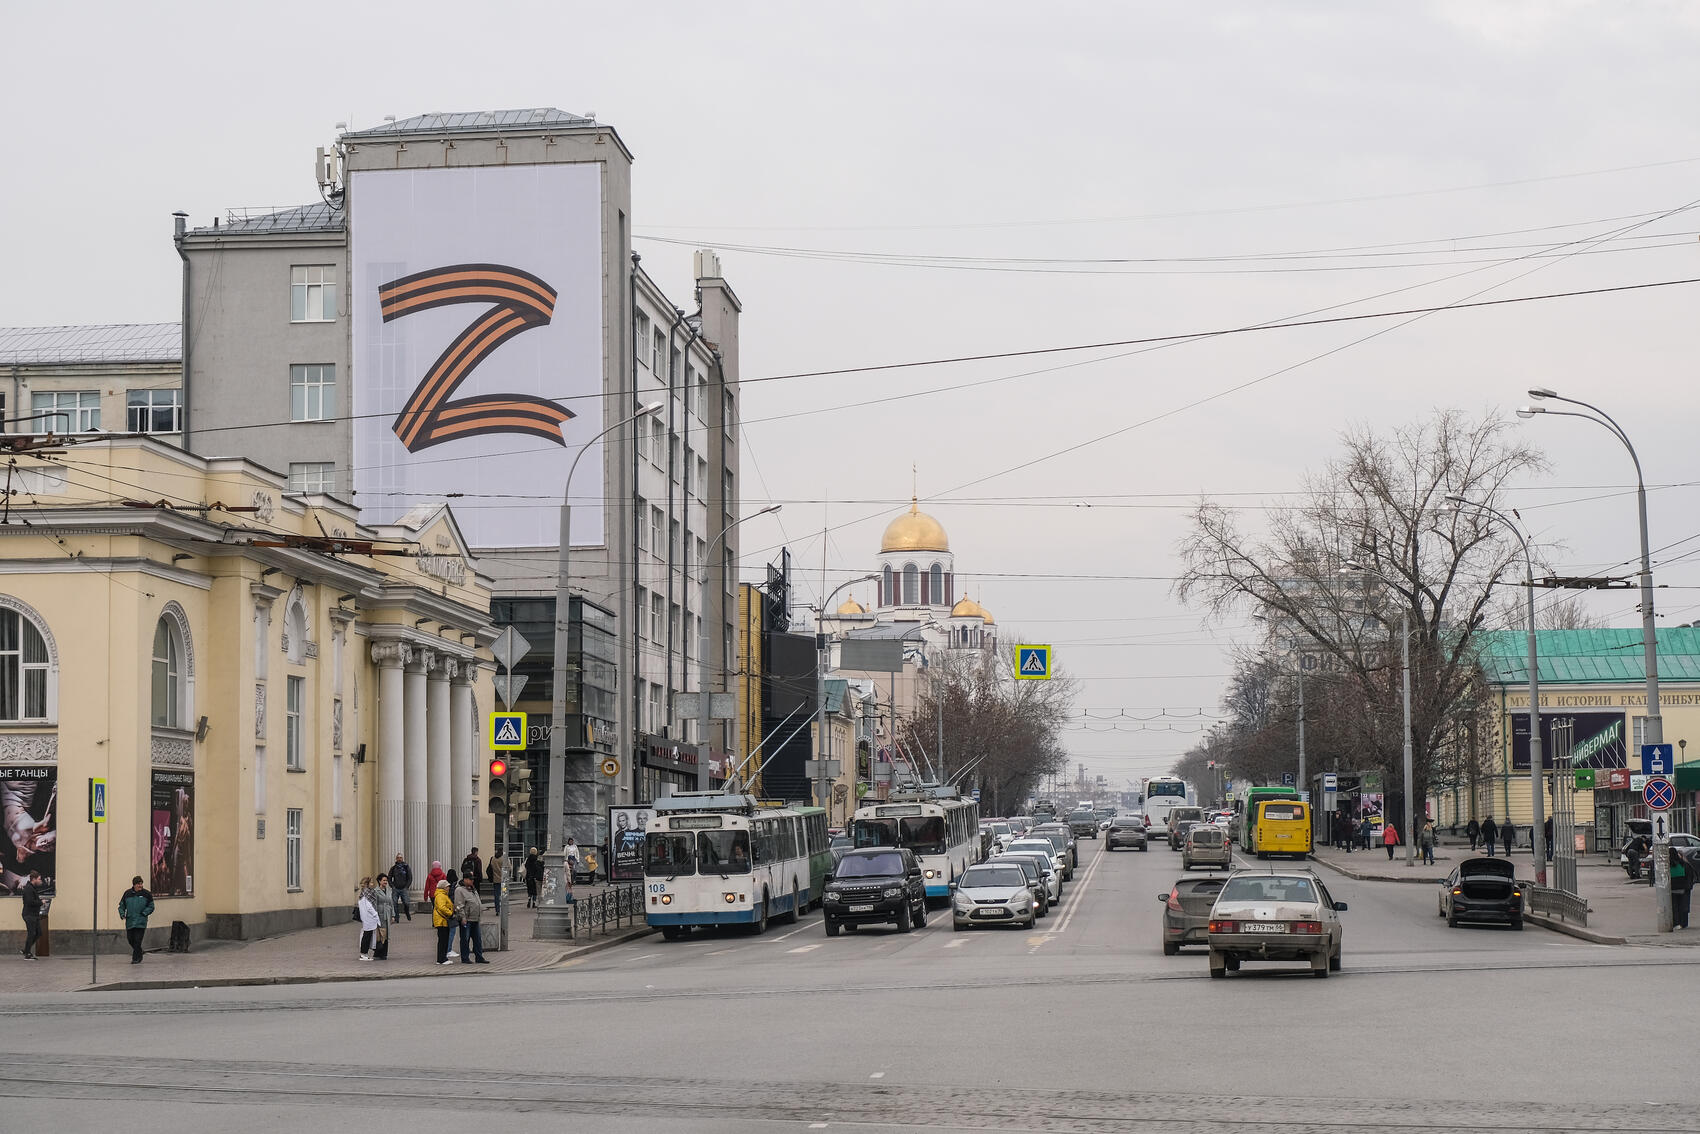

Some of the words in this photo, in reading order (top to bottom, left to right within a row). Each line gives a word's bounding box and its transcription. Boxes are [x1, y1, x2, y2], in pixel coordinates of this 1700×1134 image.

[378, 262, 576, 453] Z
[1557, 695, 1612, 706] ИСТОРИИ
[15, 769, 48, 779] ТАНЦЫ
[648, 883, 666, 893] 108
